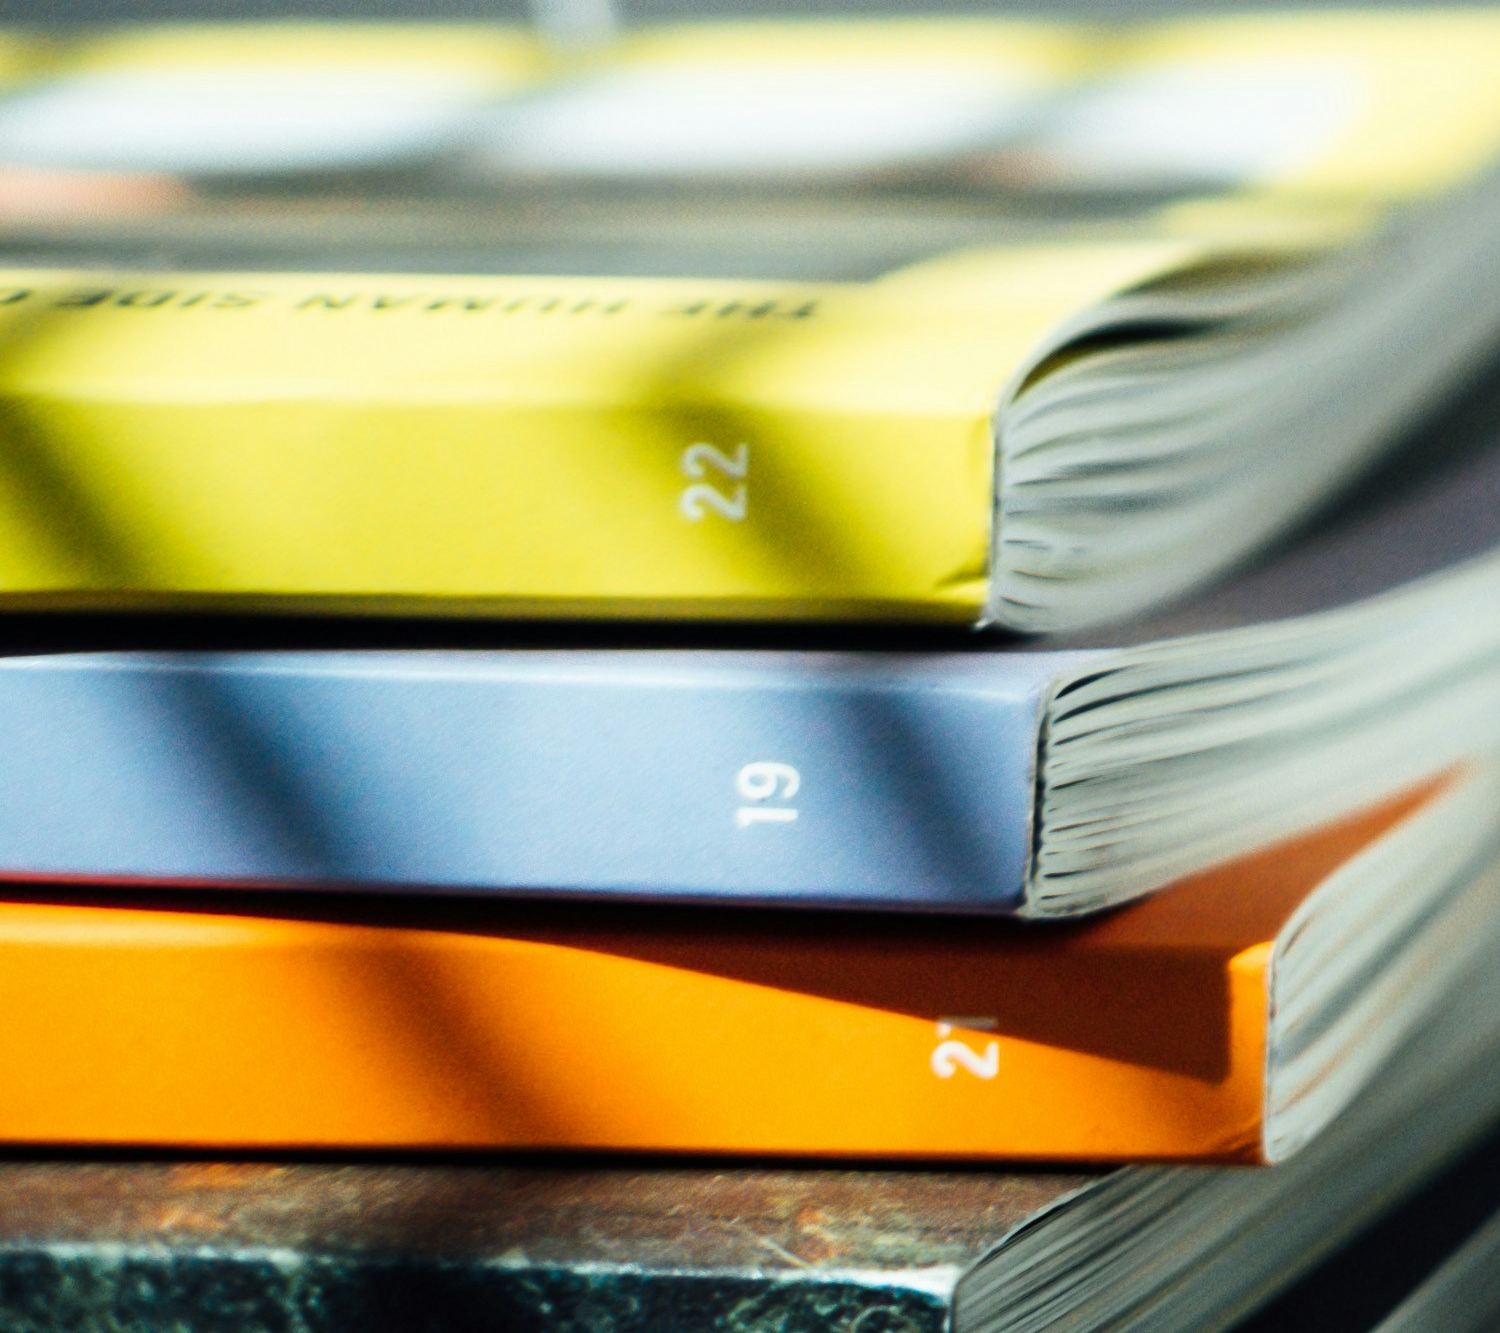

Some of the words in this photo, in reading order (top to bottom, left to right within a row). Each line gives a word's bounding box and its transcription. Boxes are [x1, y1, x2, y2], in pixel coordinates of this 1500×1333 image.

[50, 288, 272, 310] SIDE
[295, 291, 634, 316] HUMAN
[654, 297, 820, 320] THE
[681, 441, 749, 523] 22
[736, 761, 801, 829] 19
[930, 1015, 1000, 1080] 21
